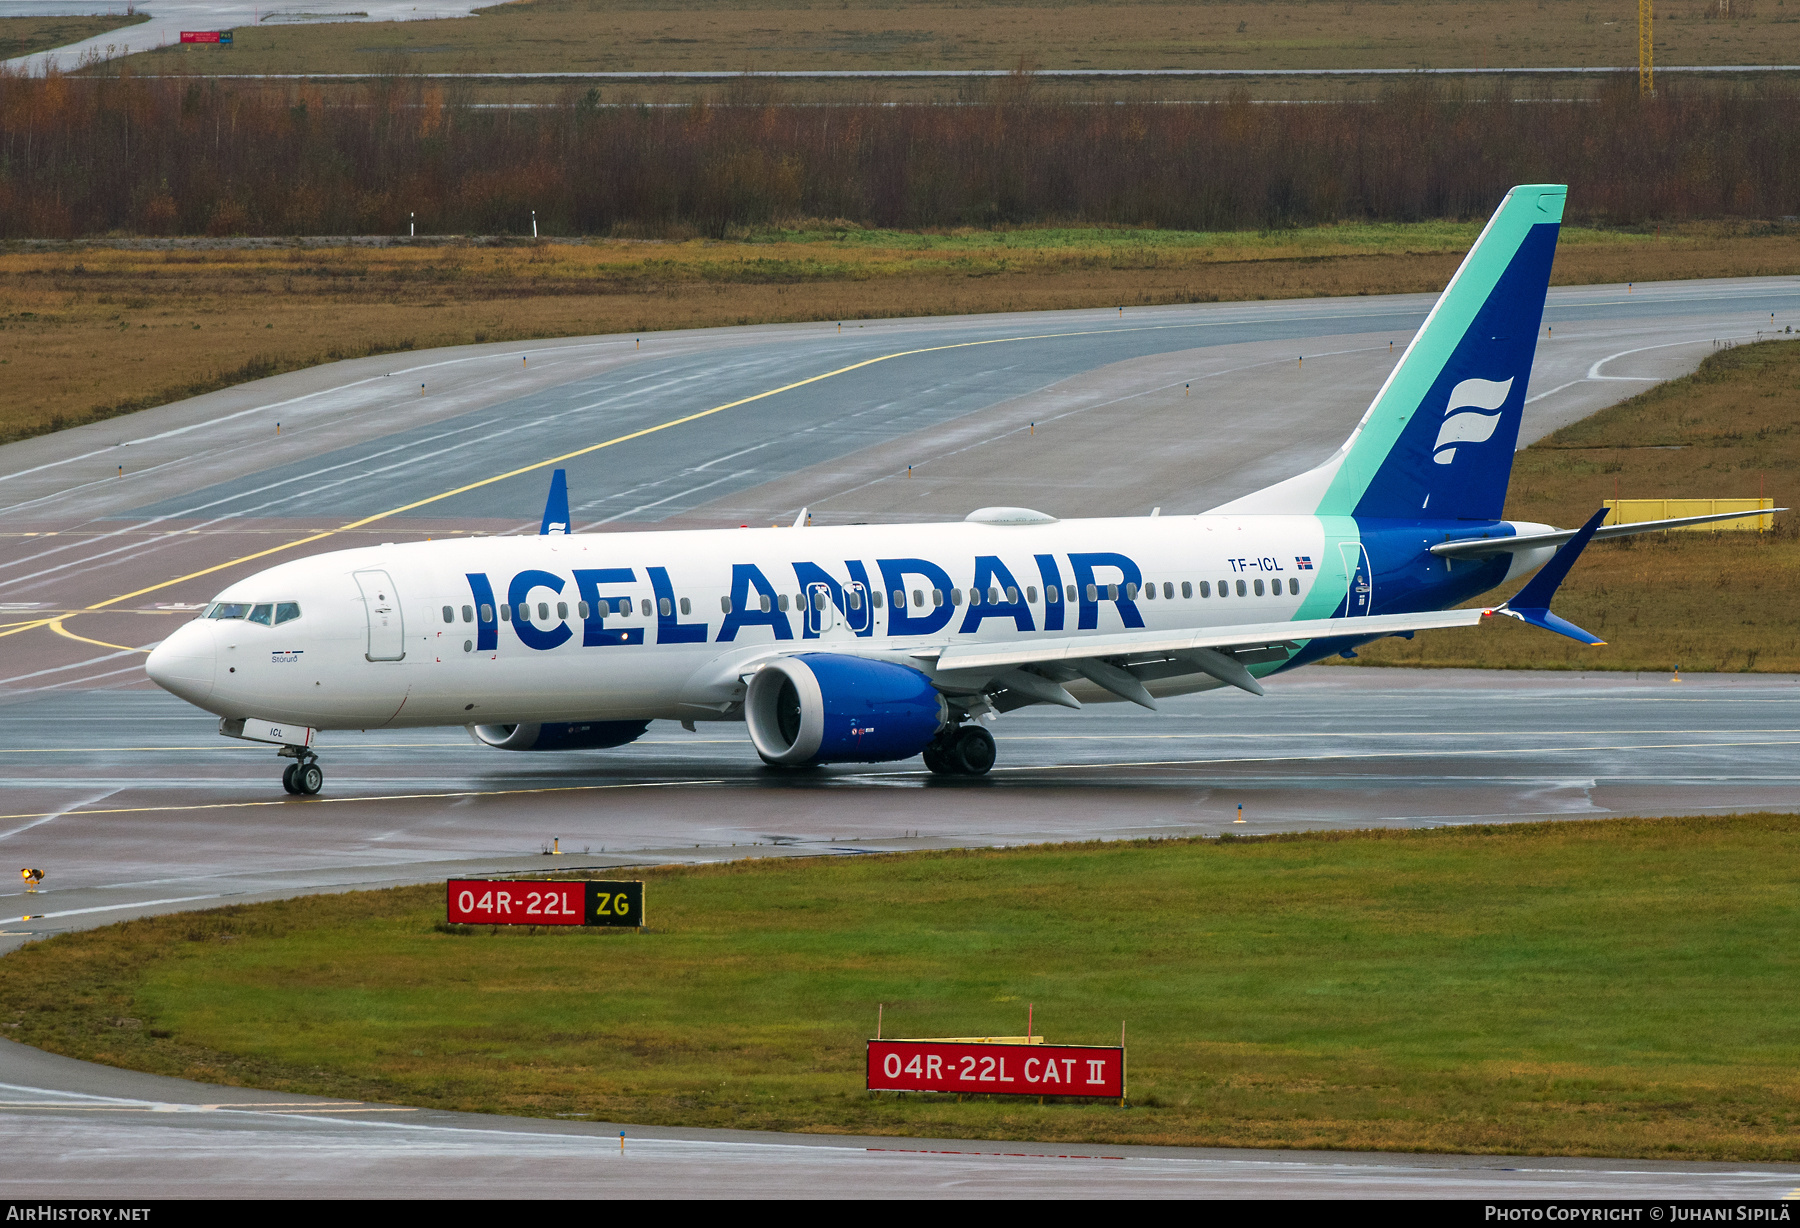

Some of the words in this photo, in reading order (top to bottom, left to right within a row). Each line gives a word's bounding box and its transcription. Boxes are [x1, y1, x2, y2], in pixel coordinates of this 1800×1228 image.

[1227, 557, 1284, 572] TF-ICL
[465, 552, 1145, 650] ICELANDAIR
[270, 727, 283, 738] ICL
[458, 890, 576, 915] 04R-22L
[596, 893, 629, 915] ZG
[884, 1053, 1014, 1082] 04R-22L
[1024, 1057, 1077, 1084] CAT
[1086, 1059, 1106, 1085] II
